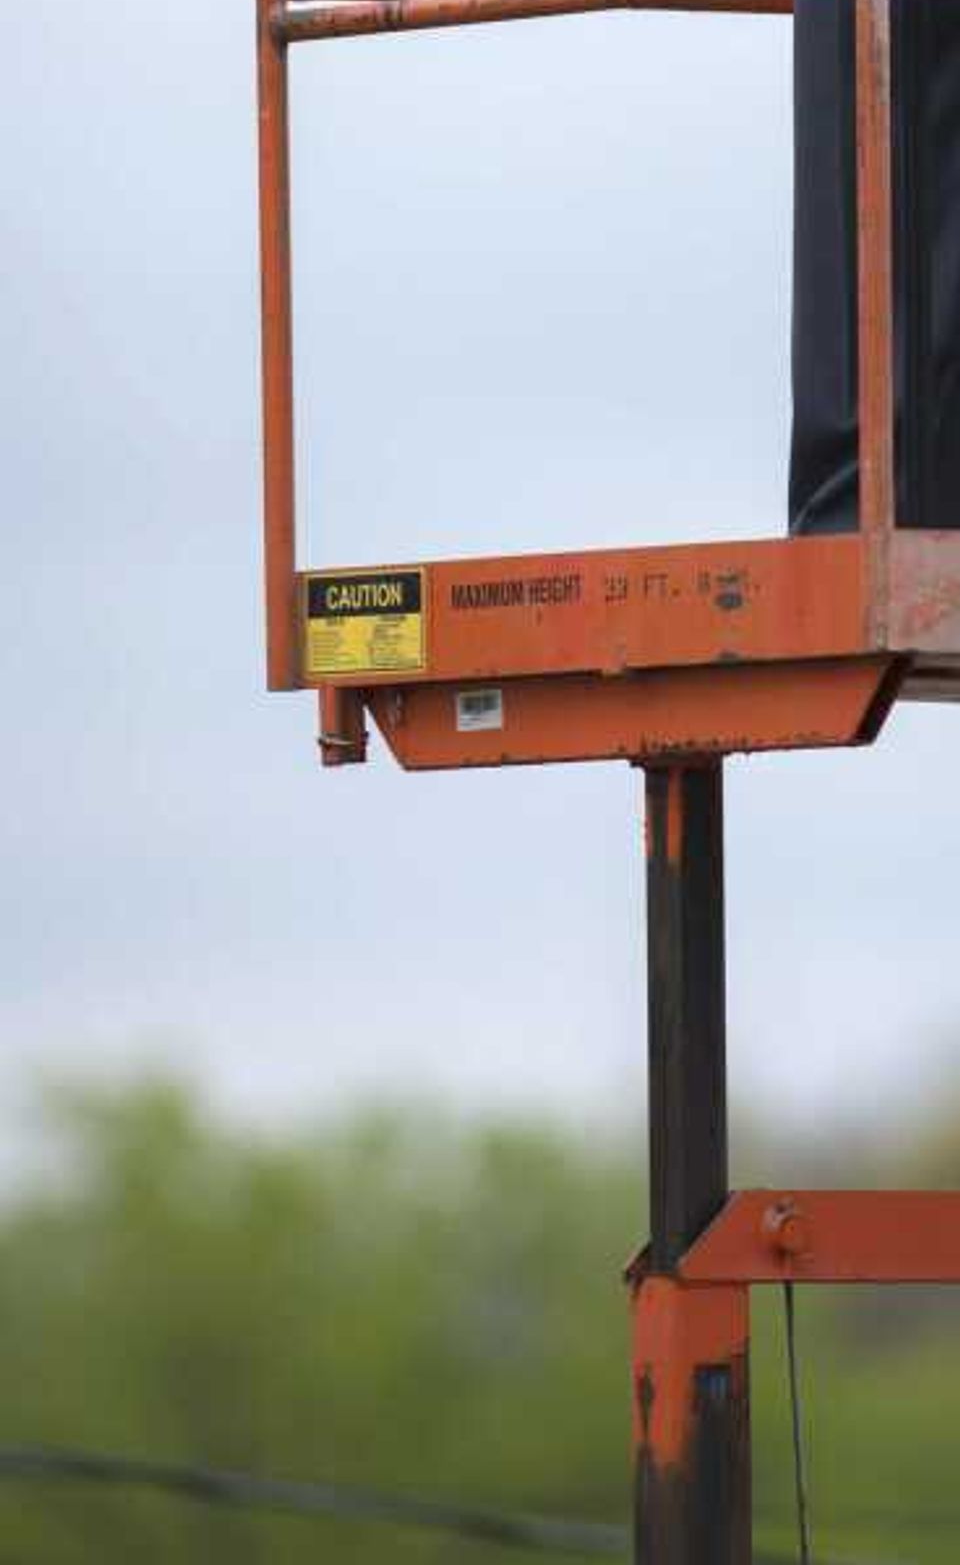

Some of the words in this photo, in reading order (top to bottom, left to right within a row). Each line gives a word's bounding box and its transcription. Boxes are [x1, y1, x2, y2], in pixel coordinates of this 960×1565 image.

[325, 582, 403, 609] CAUTION
[450, 581, 523, 608] MAXIMUM
[527, 574, 581, 606] HEIGHT
